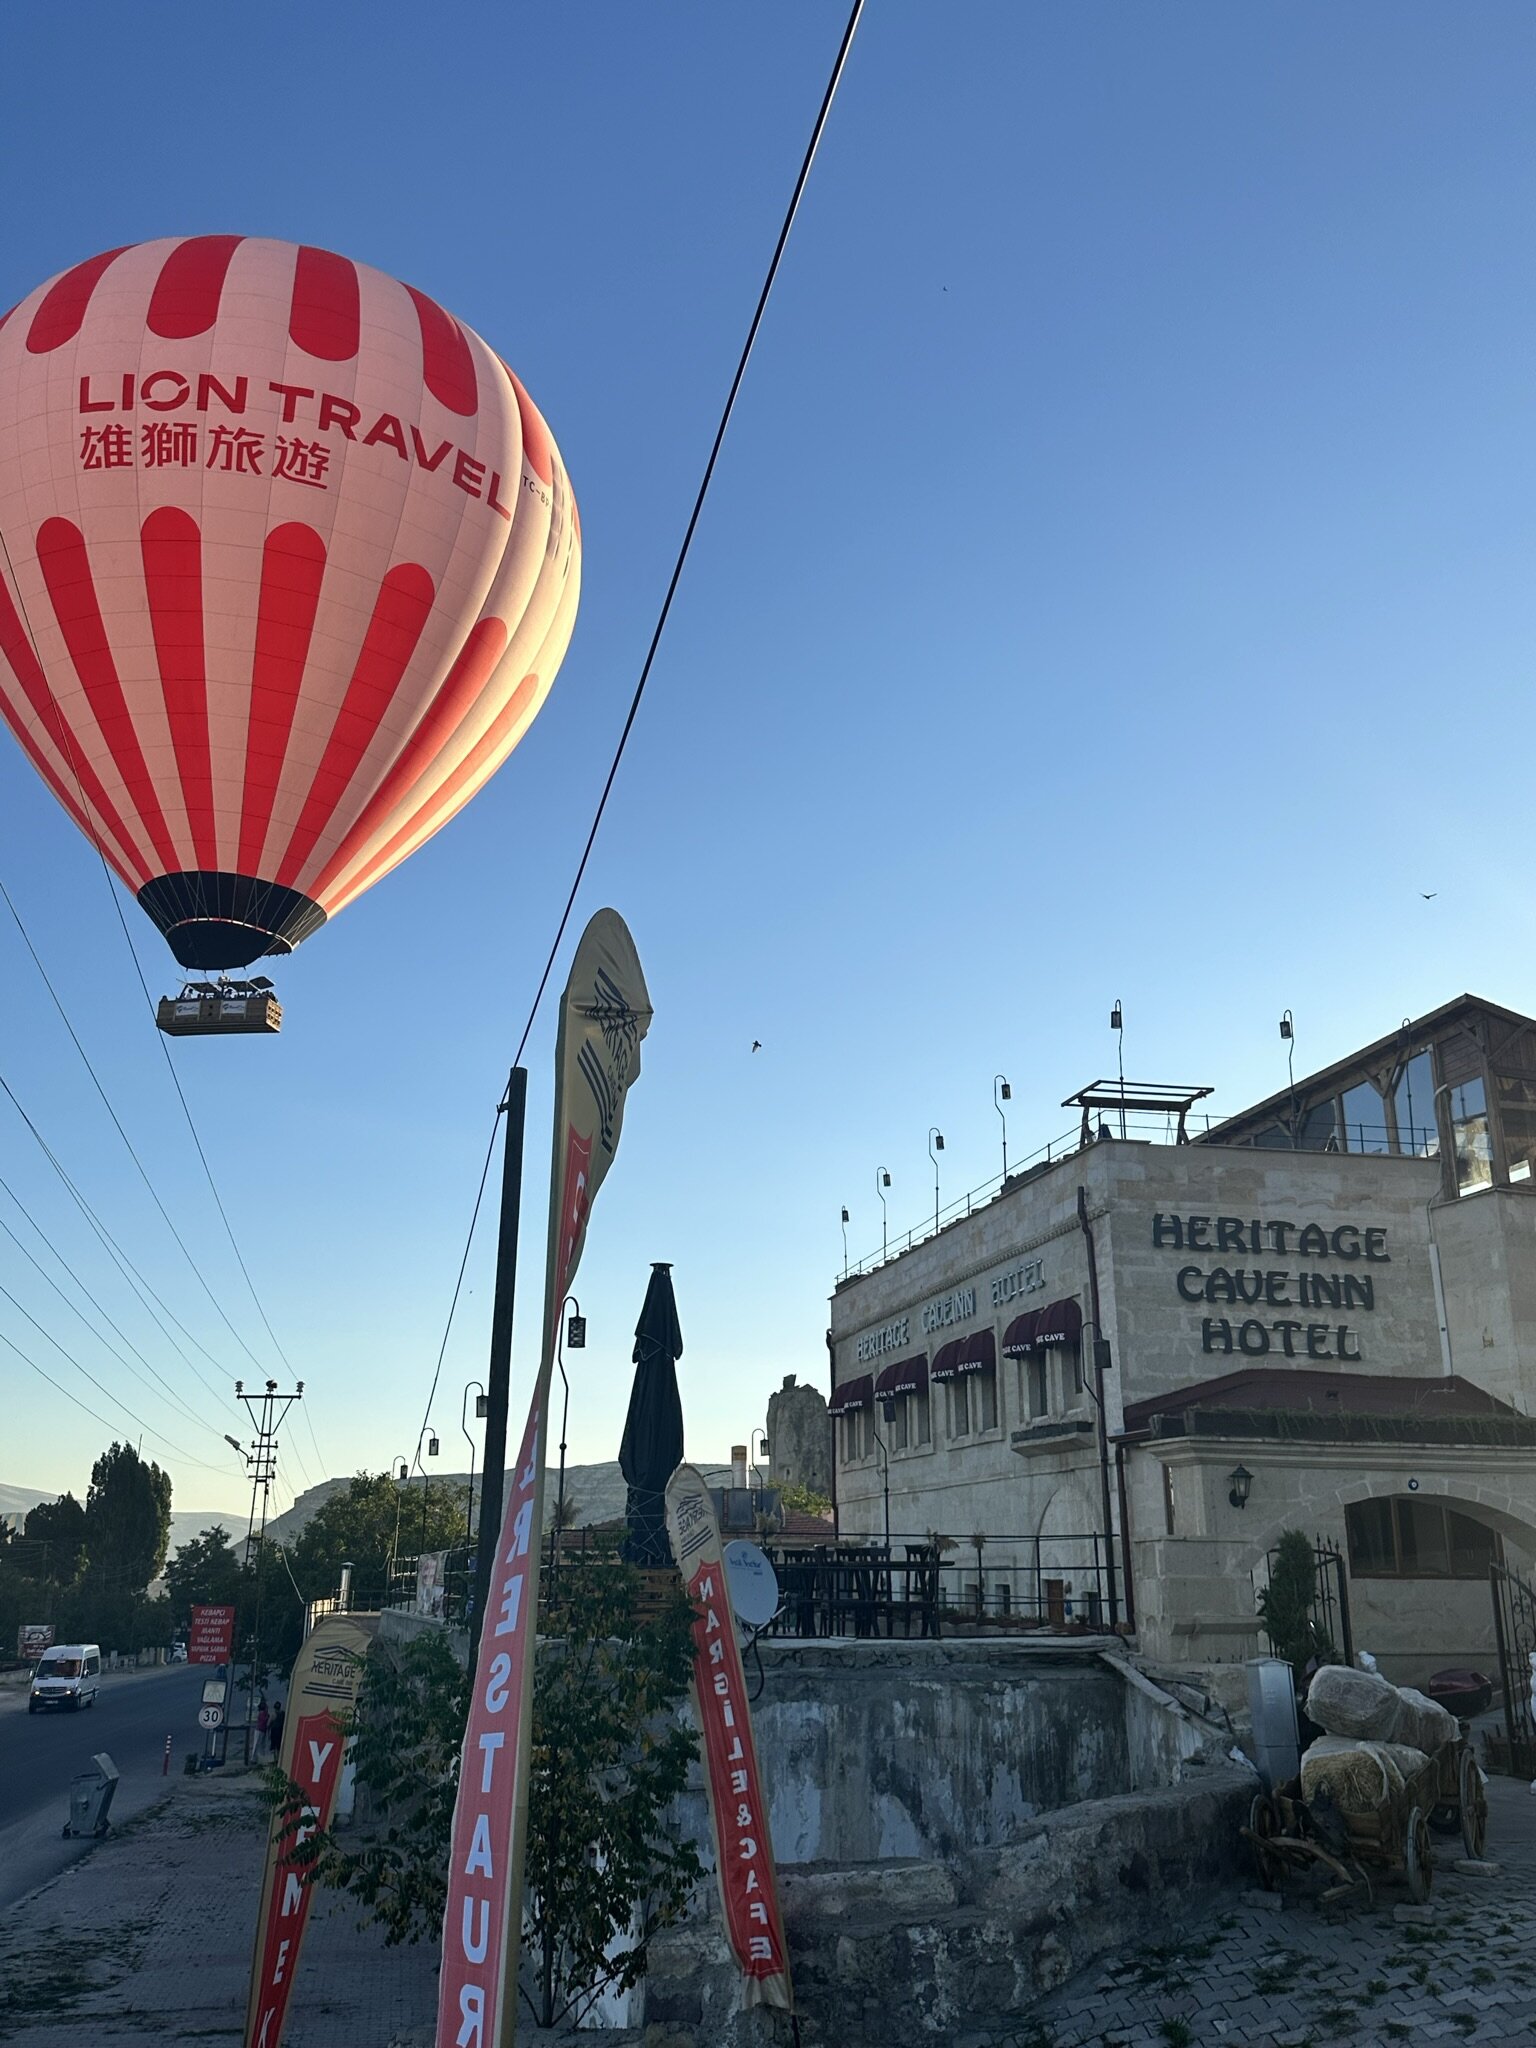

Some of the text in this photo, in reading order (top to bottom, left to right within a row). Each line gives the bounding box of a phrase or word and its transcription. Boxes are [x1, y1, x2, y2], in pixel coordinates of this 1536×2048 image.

[80, 371, 248, 414] LION
[269, 382, 511, 522] TRAVEL
[80, 422, 331, 490] 雄獅旅遊
[1153, 1214, 1391, 1262] HERITAGE
[857, 1317, 910, 1361] HERITAGE
[1012, 1344, 1031, 1352] CAVE
[1044, 1333, 1065, 1342] CAVE
[1202, 1318, 1361, 1360] HOTEL
[311, 1660, 358, 1678] HERITAGE
[203, 1711, 219, 1722] 30
